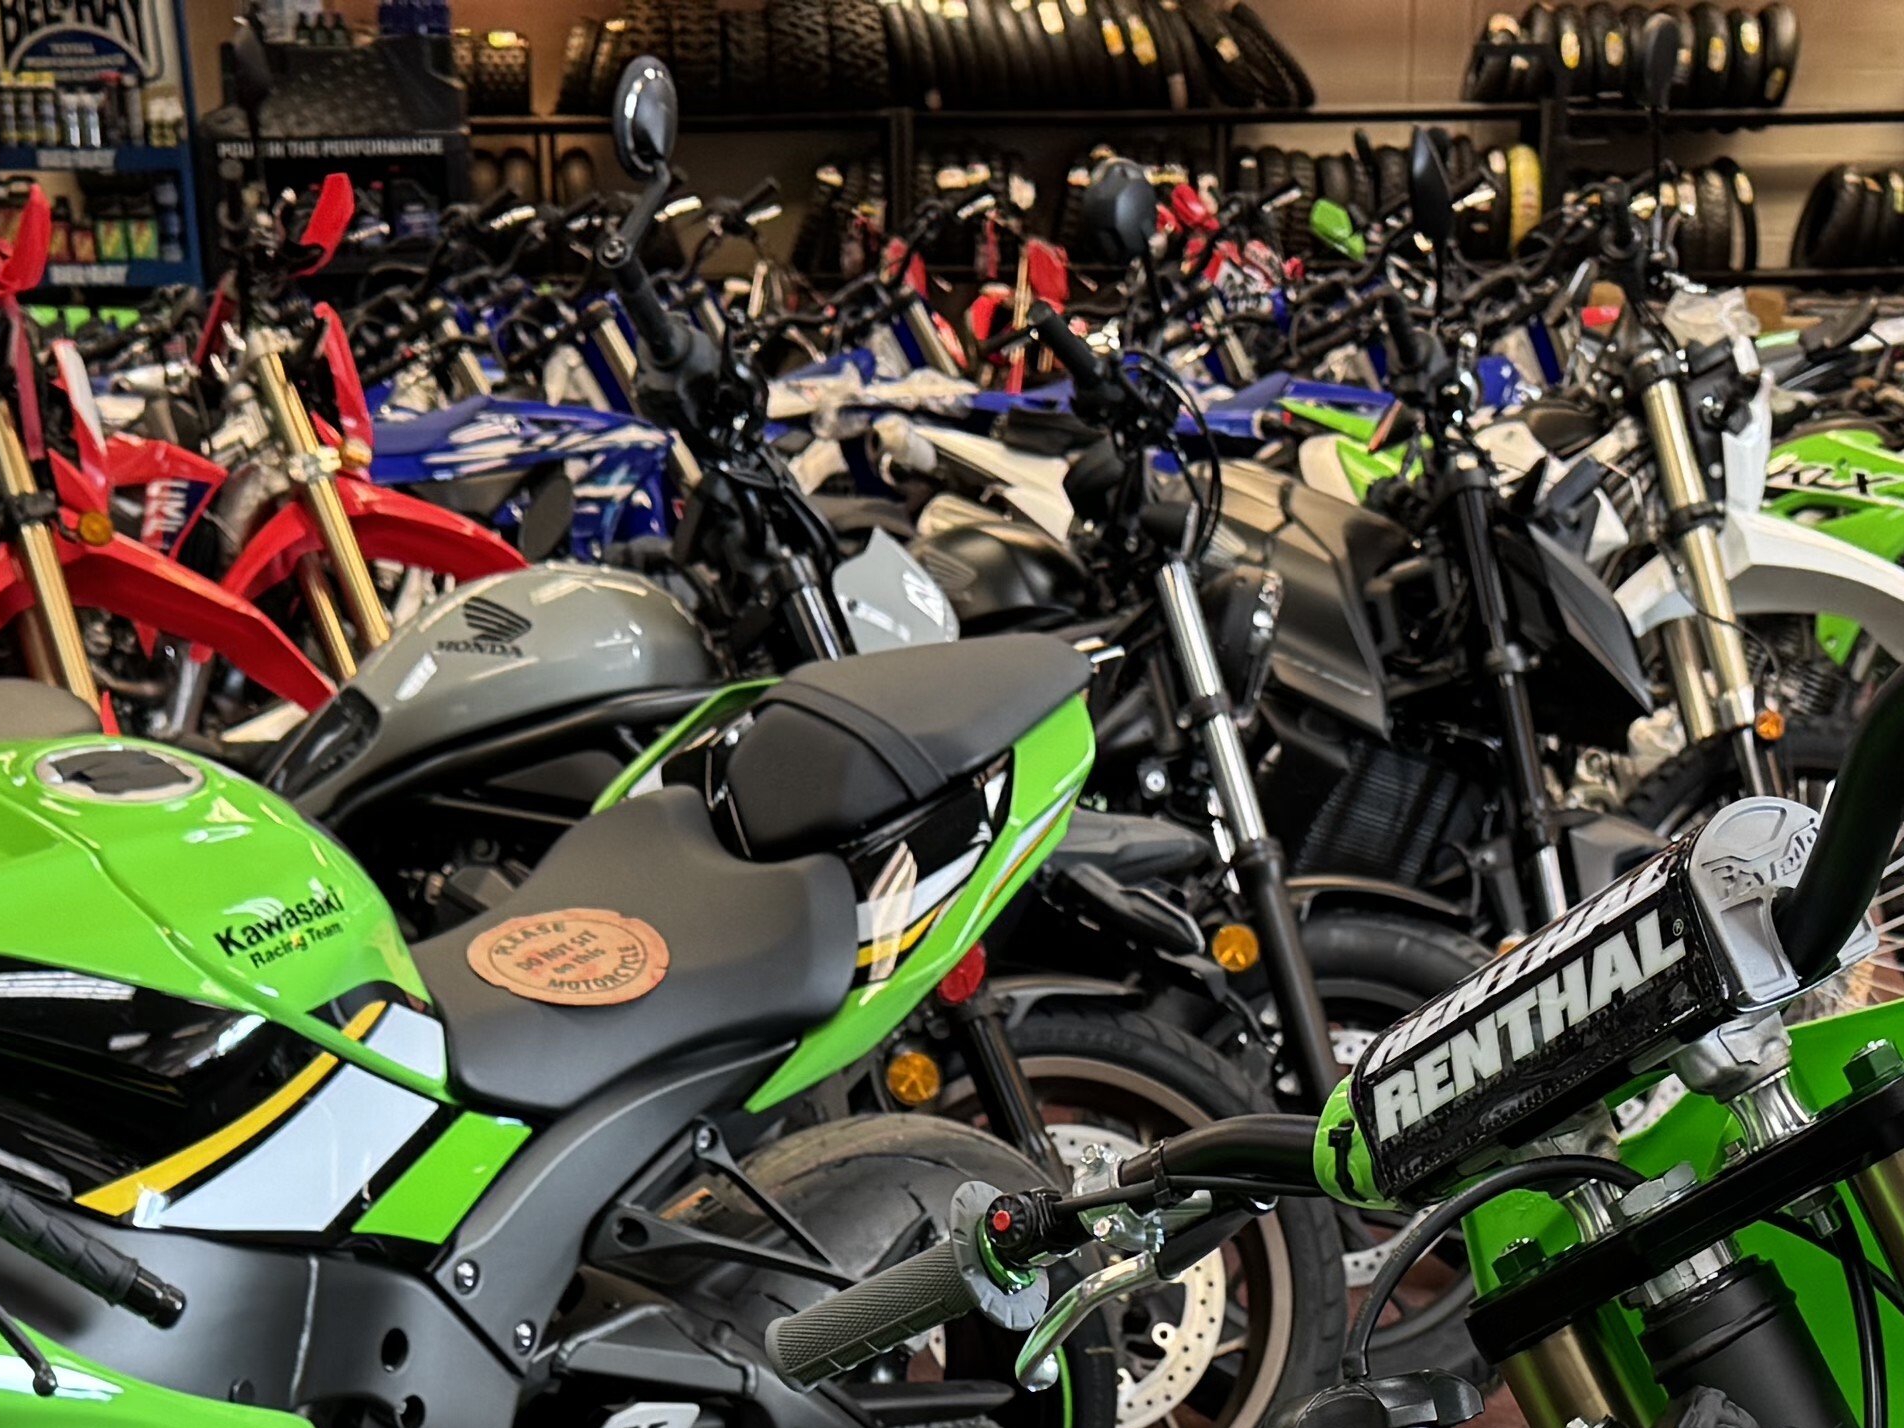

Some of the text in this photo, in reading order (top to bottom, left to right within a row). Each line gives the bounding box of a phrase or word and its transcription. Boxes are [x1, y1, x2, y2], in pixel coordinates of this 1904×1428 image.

[437, 641, 524, 659] HONDA
[213, 884, 345, 958] Kawasaki
[306, 922, 344, 943] Team
[496, 921, 566, 957] PLEASE
[515, 929, 599, 971] DO NOT SIT
[547, 943, 642, 992] MOTORCYCLE
[552, 947, 607, 975] on this
[1372, 908, 1686, 1143] RENTHAL
